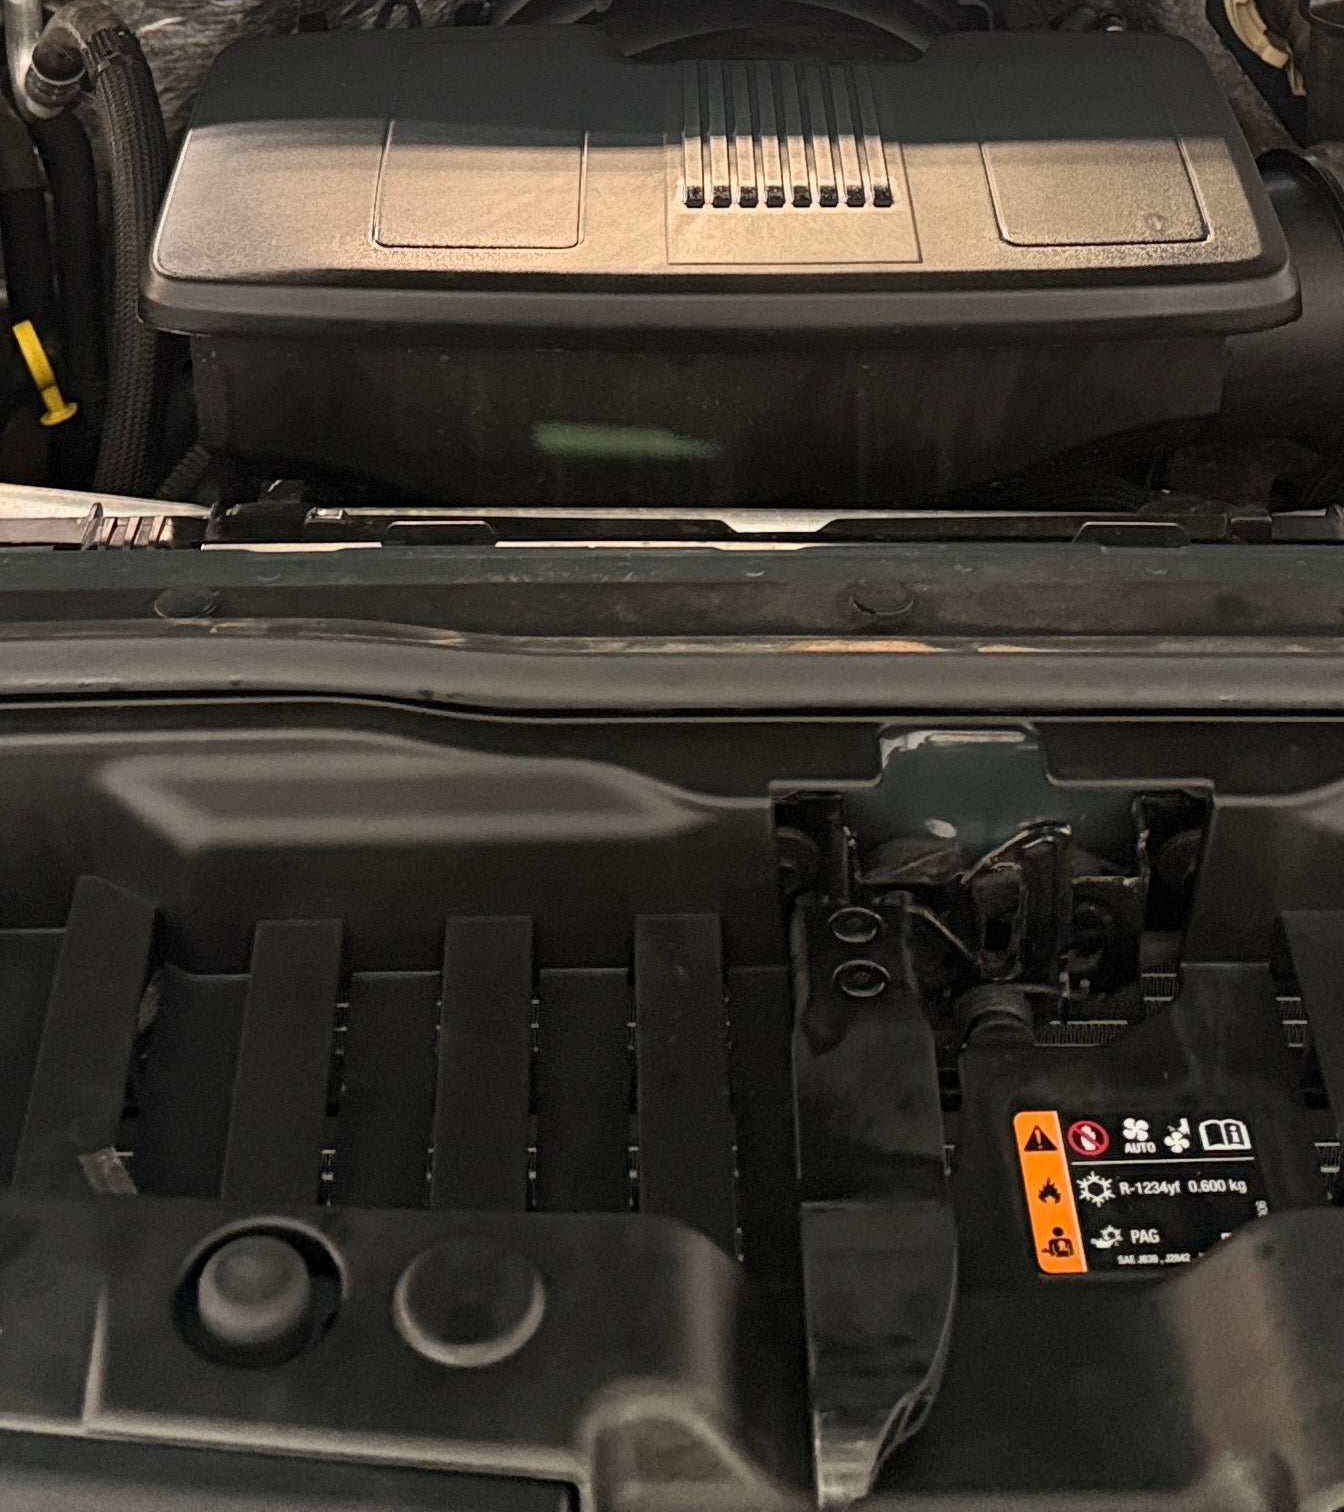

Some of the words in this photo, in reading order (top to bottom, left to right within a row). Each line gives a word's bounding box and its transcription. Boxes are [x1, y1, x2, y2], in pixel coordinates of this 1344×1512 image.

[1124, 1142, 1156, 1154] AUTO
[1119, 1180, 1181, 1196] R-1234yf
[1188, 1179, 1226, 1193] 0.600
[1229, 1179, 1247, 1194] kg
[1130, 1229, 1161, 1244] PAG
